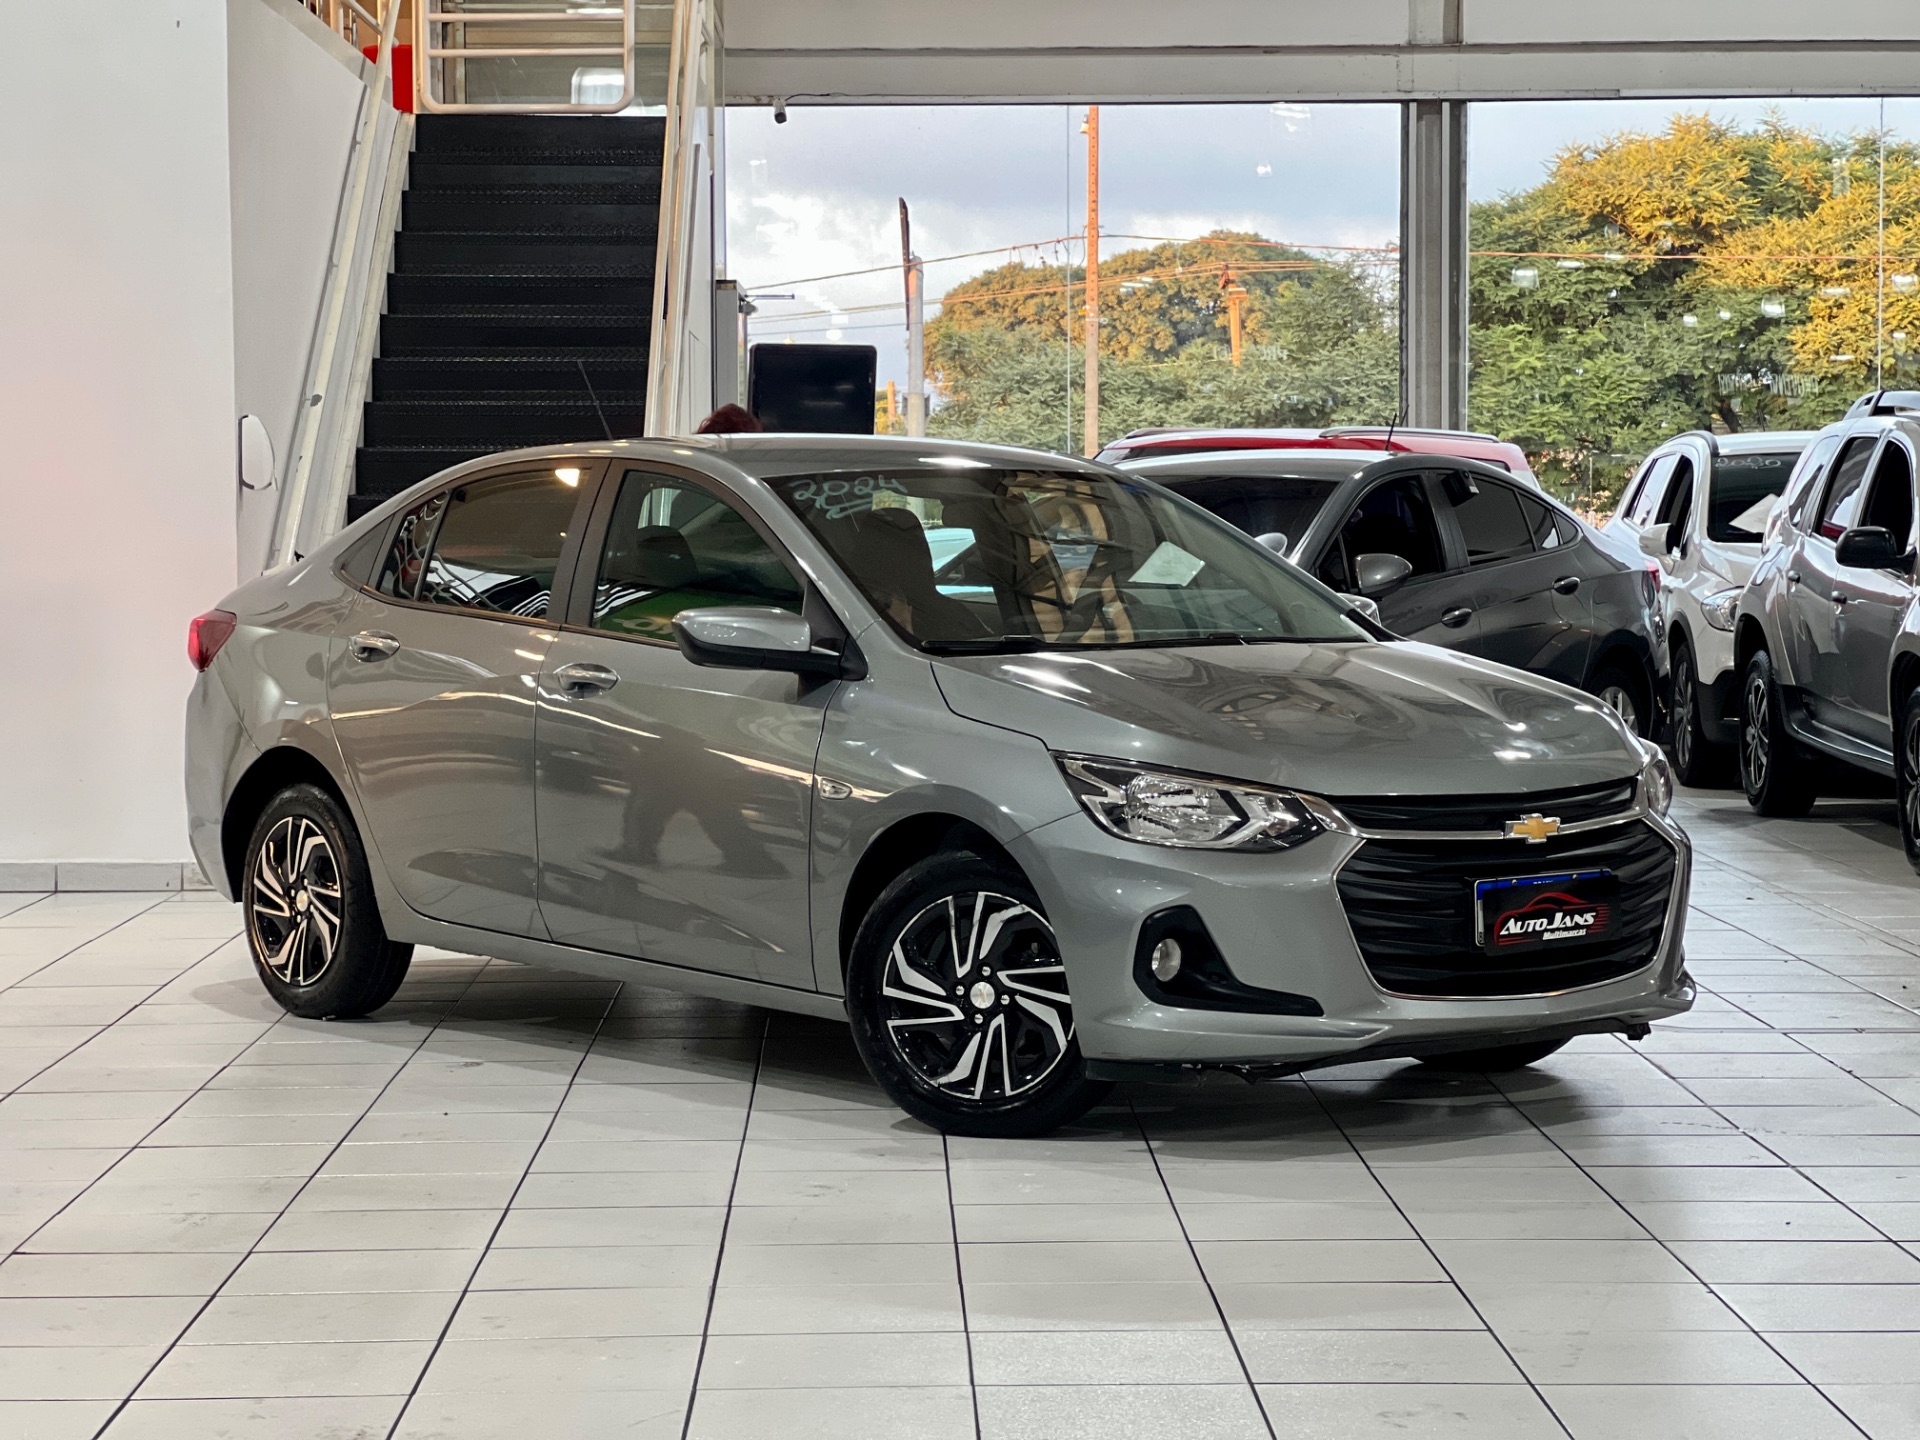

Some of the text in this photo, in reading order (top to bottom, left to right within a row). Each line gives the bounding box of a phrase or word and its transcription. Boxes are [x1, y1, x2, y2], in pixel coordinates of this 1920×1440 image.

[789, 474, 909, 501] 2024
[1499, 911, 1597, 936] AUTO JANS
[1542, 928, 1587, 940] Multimarcas
